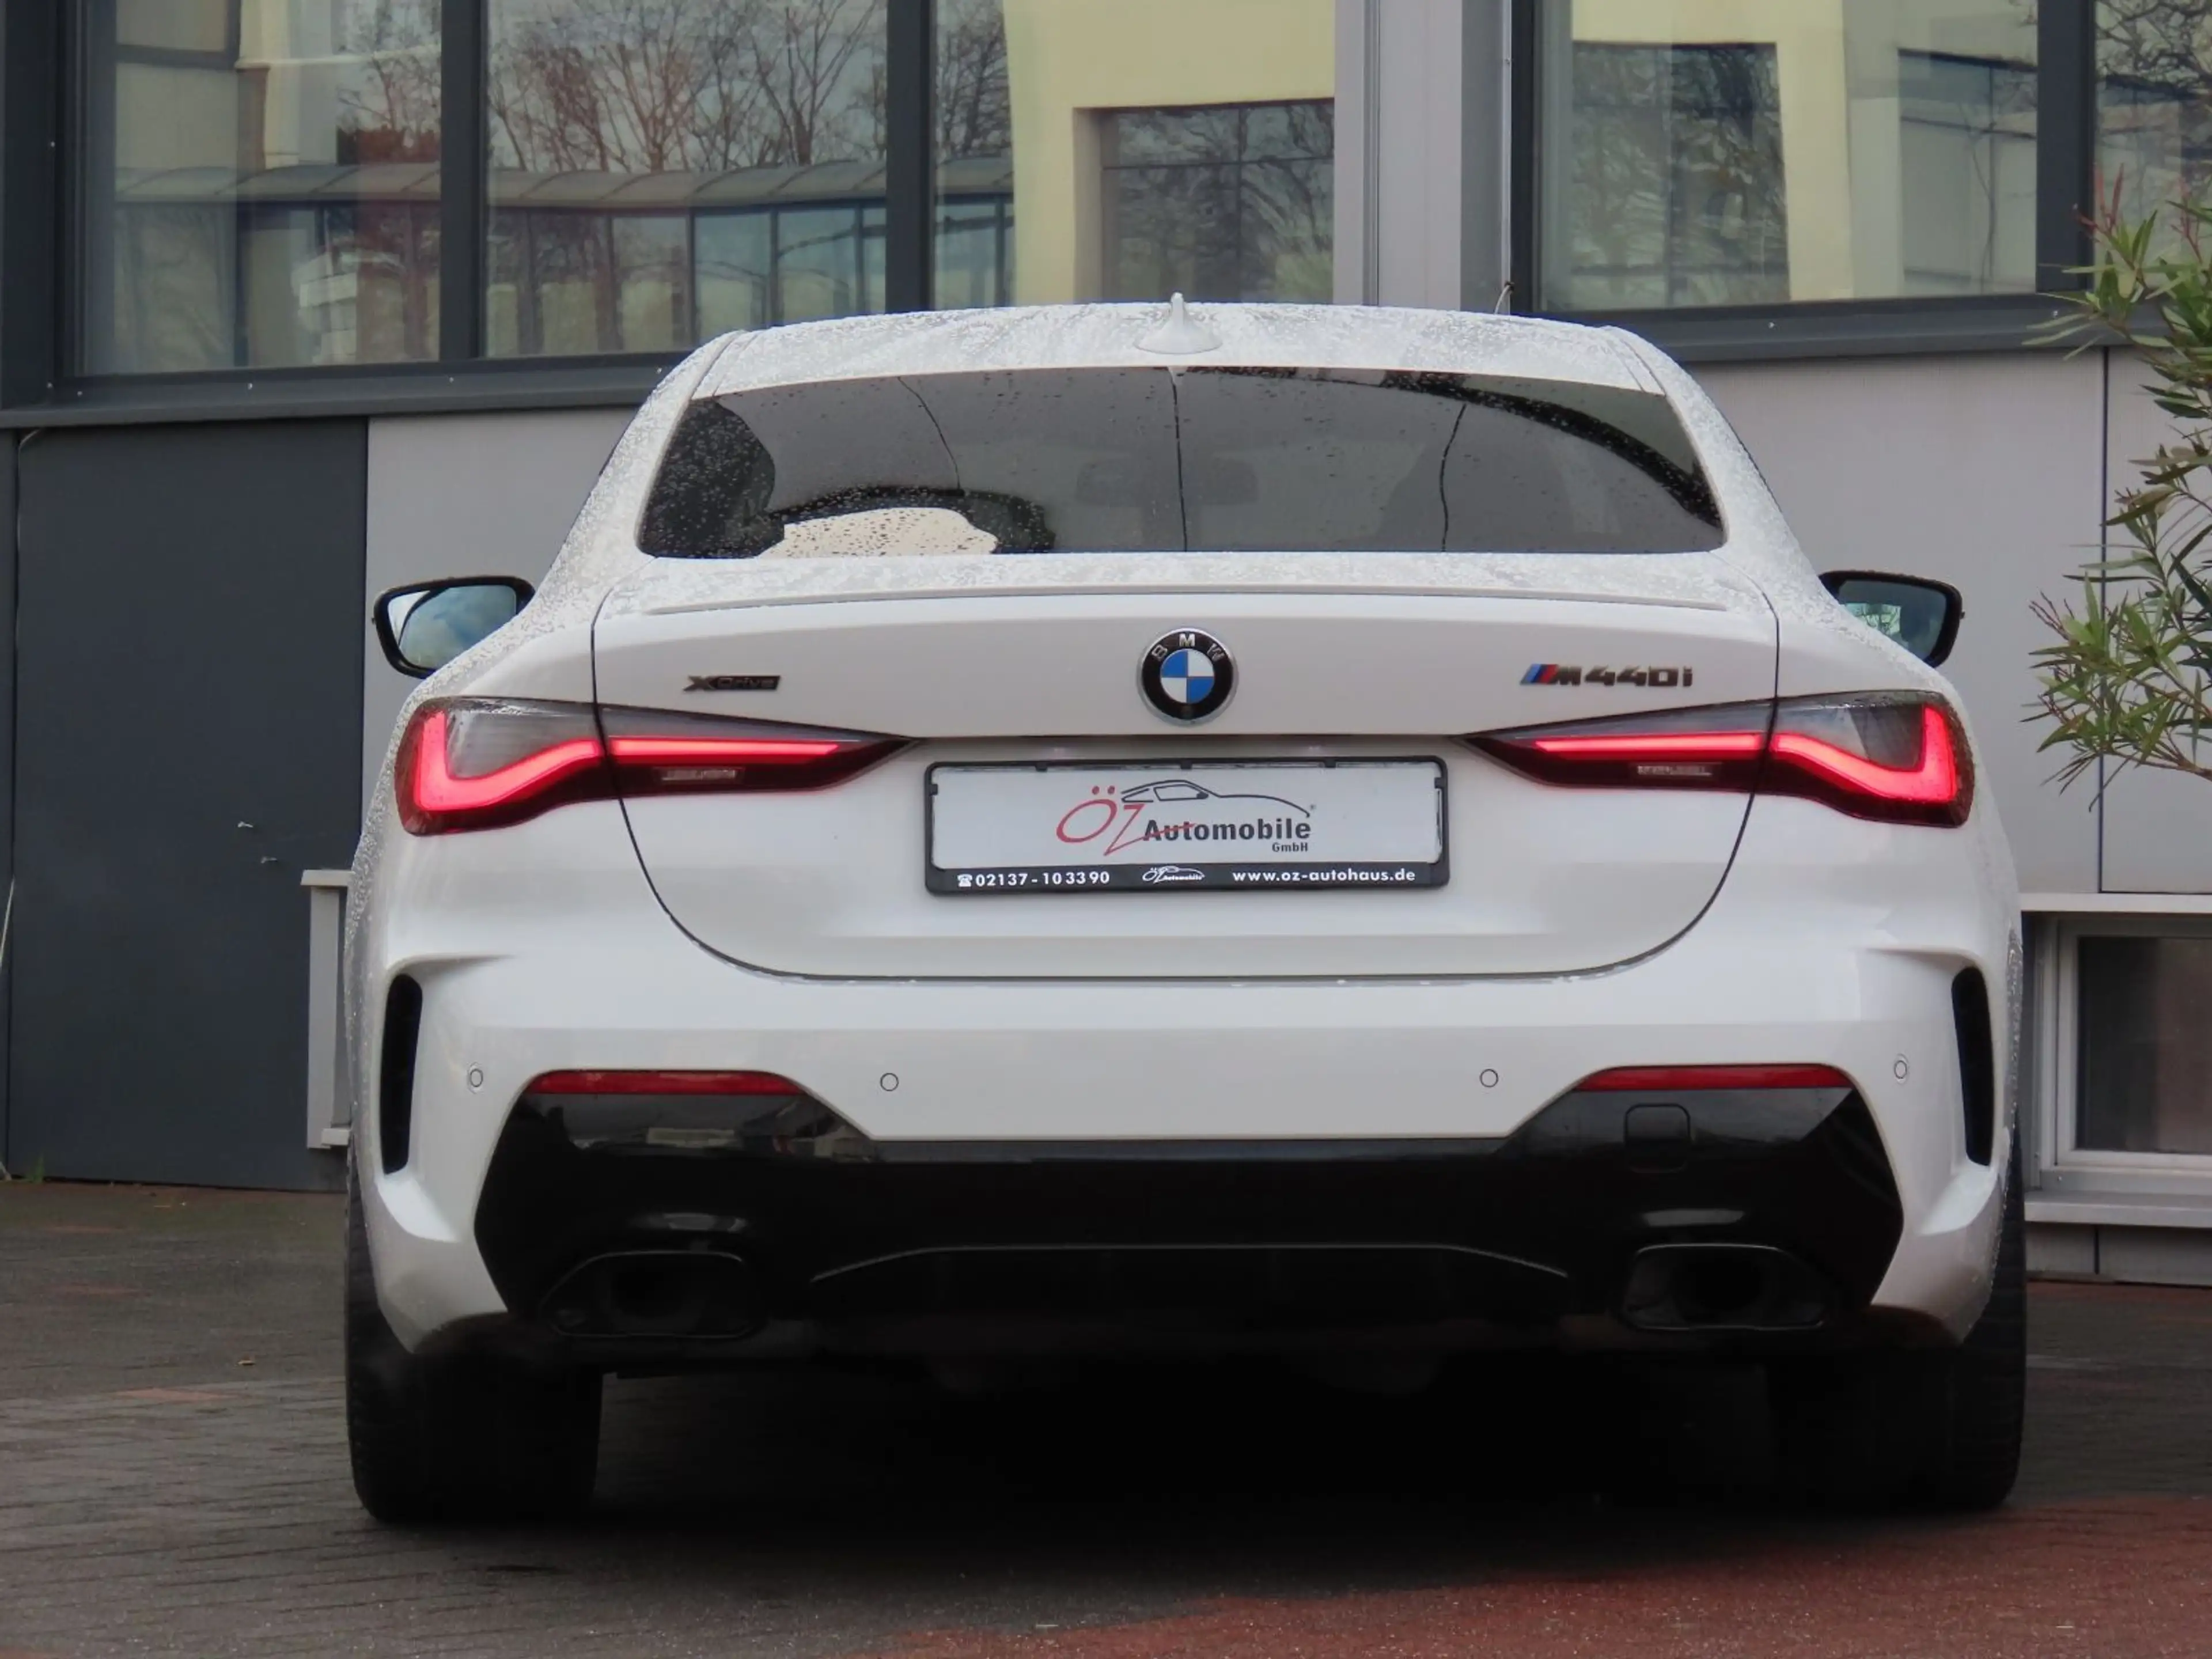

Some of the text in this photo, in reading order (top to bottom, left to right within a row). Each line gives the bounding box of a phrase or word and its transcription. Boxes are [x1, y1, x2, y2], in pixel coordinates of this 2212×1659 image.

[1152, 633, 1224, 661] BMW
[1520, 664, 1693, 687] M440i
[1056, 785, 1311, 856] ÖZ Automobile
[1271, 842, 1309, 853] GmbH
[1232, 868, 1415, 881] www.oz-autohaus.de
